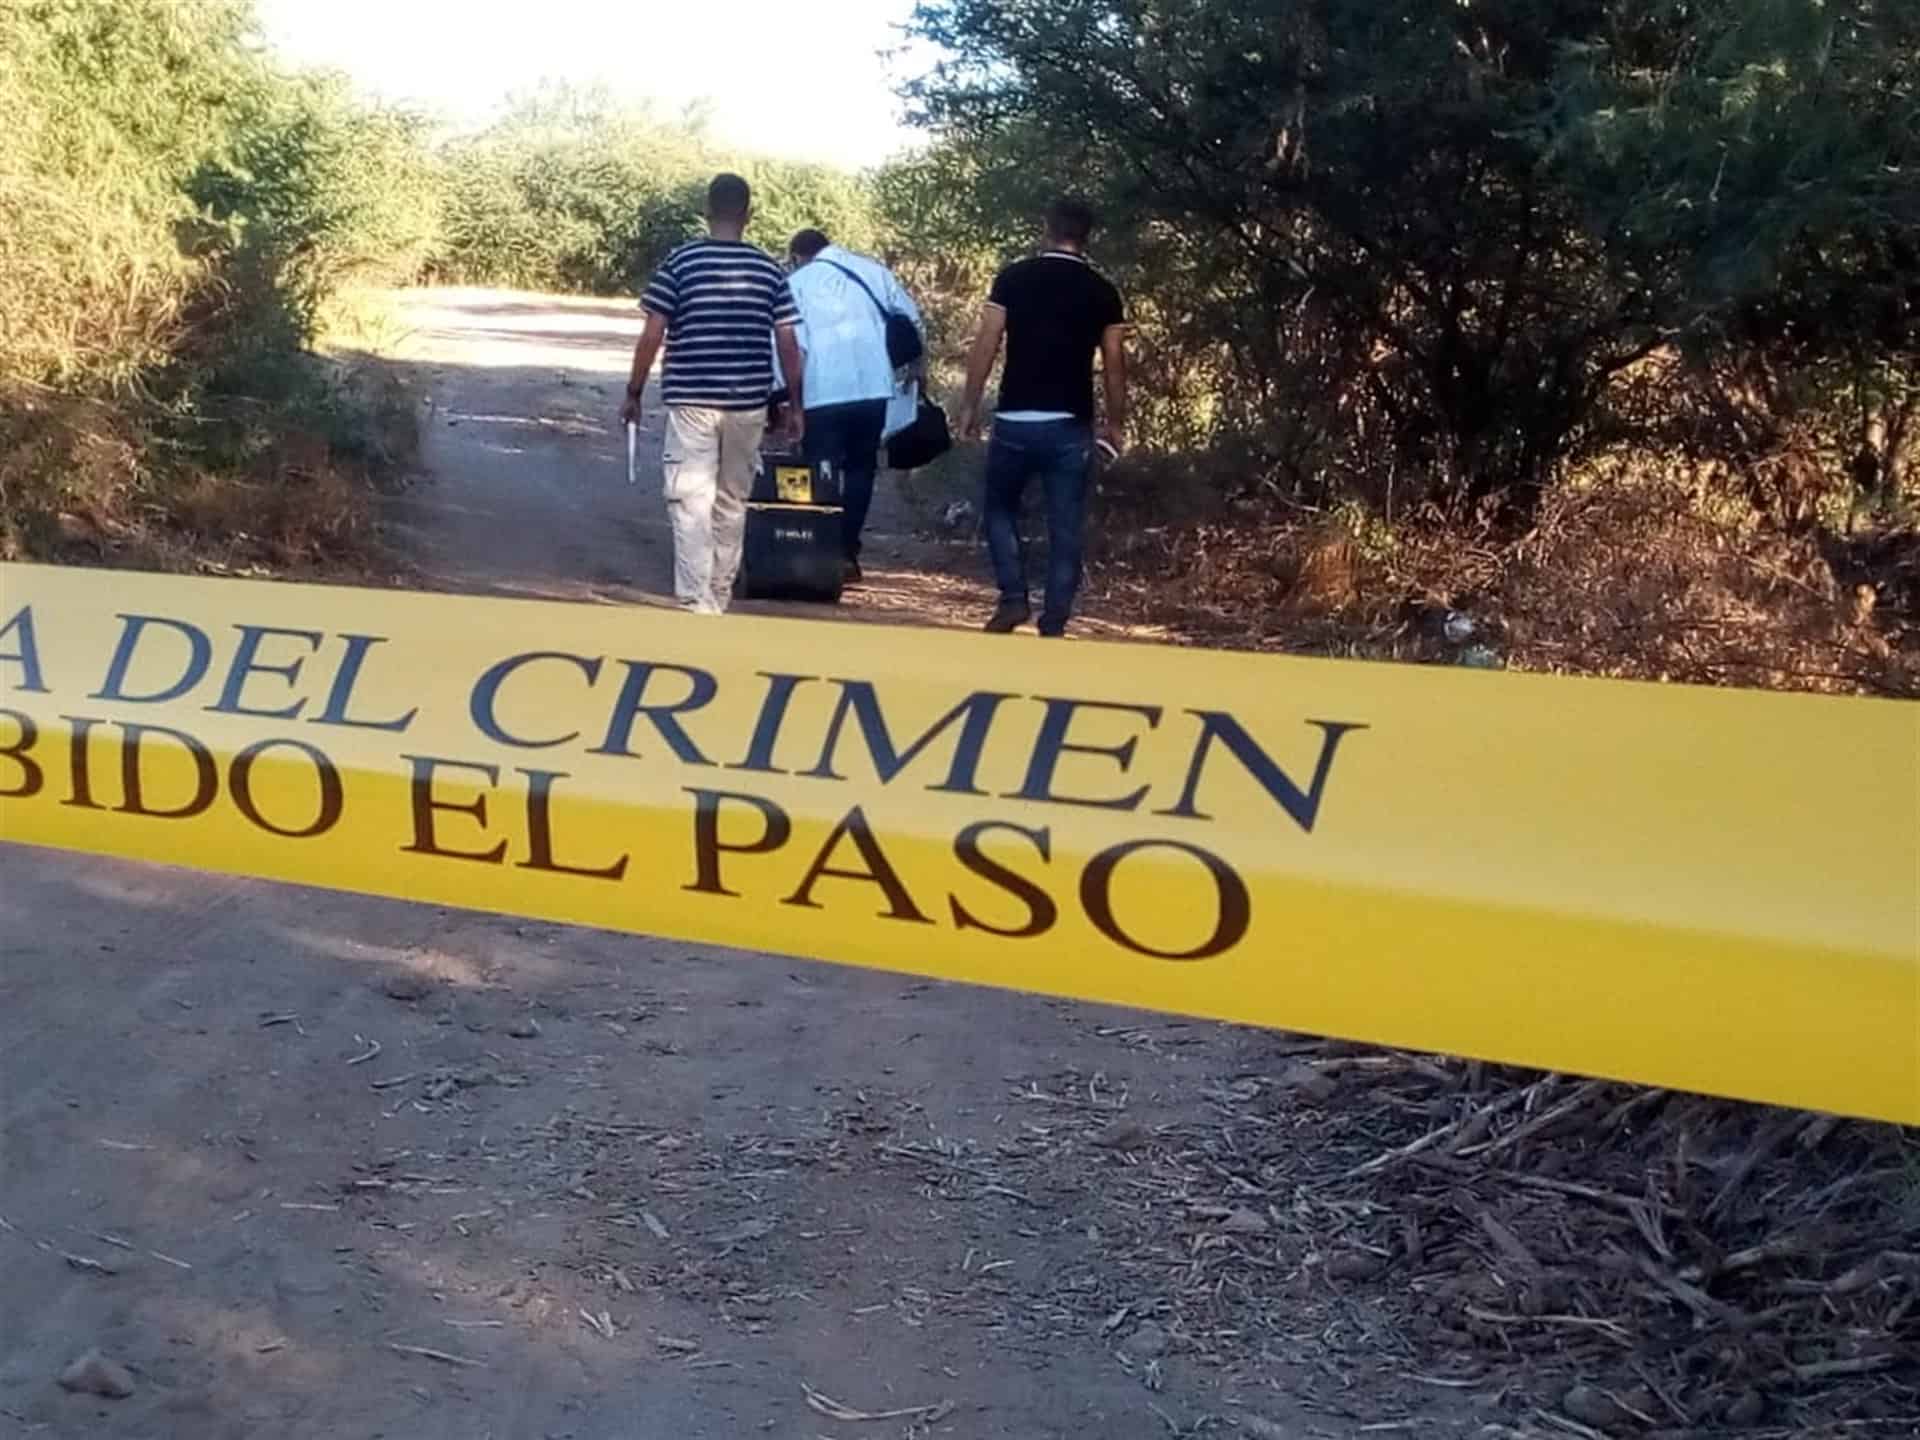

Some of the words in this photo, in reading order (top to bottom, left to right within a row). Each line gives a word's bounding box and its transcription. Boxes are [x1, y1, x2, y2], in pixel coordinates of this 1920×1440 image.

[0, 605, 52, 693] A
[87, 613, 418, 733] DEL
[469, 651, 1369, 833] CRIMEN
[400, 754, 630, 882] EL
[682, 787, 1251, 962] PASO
